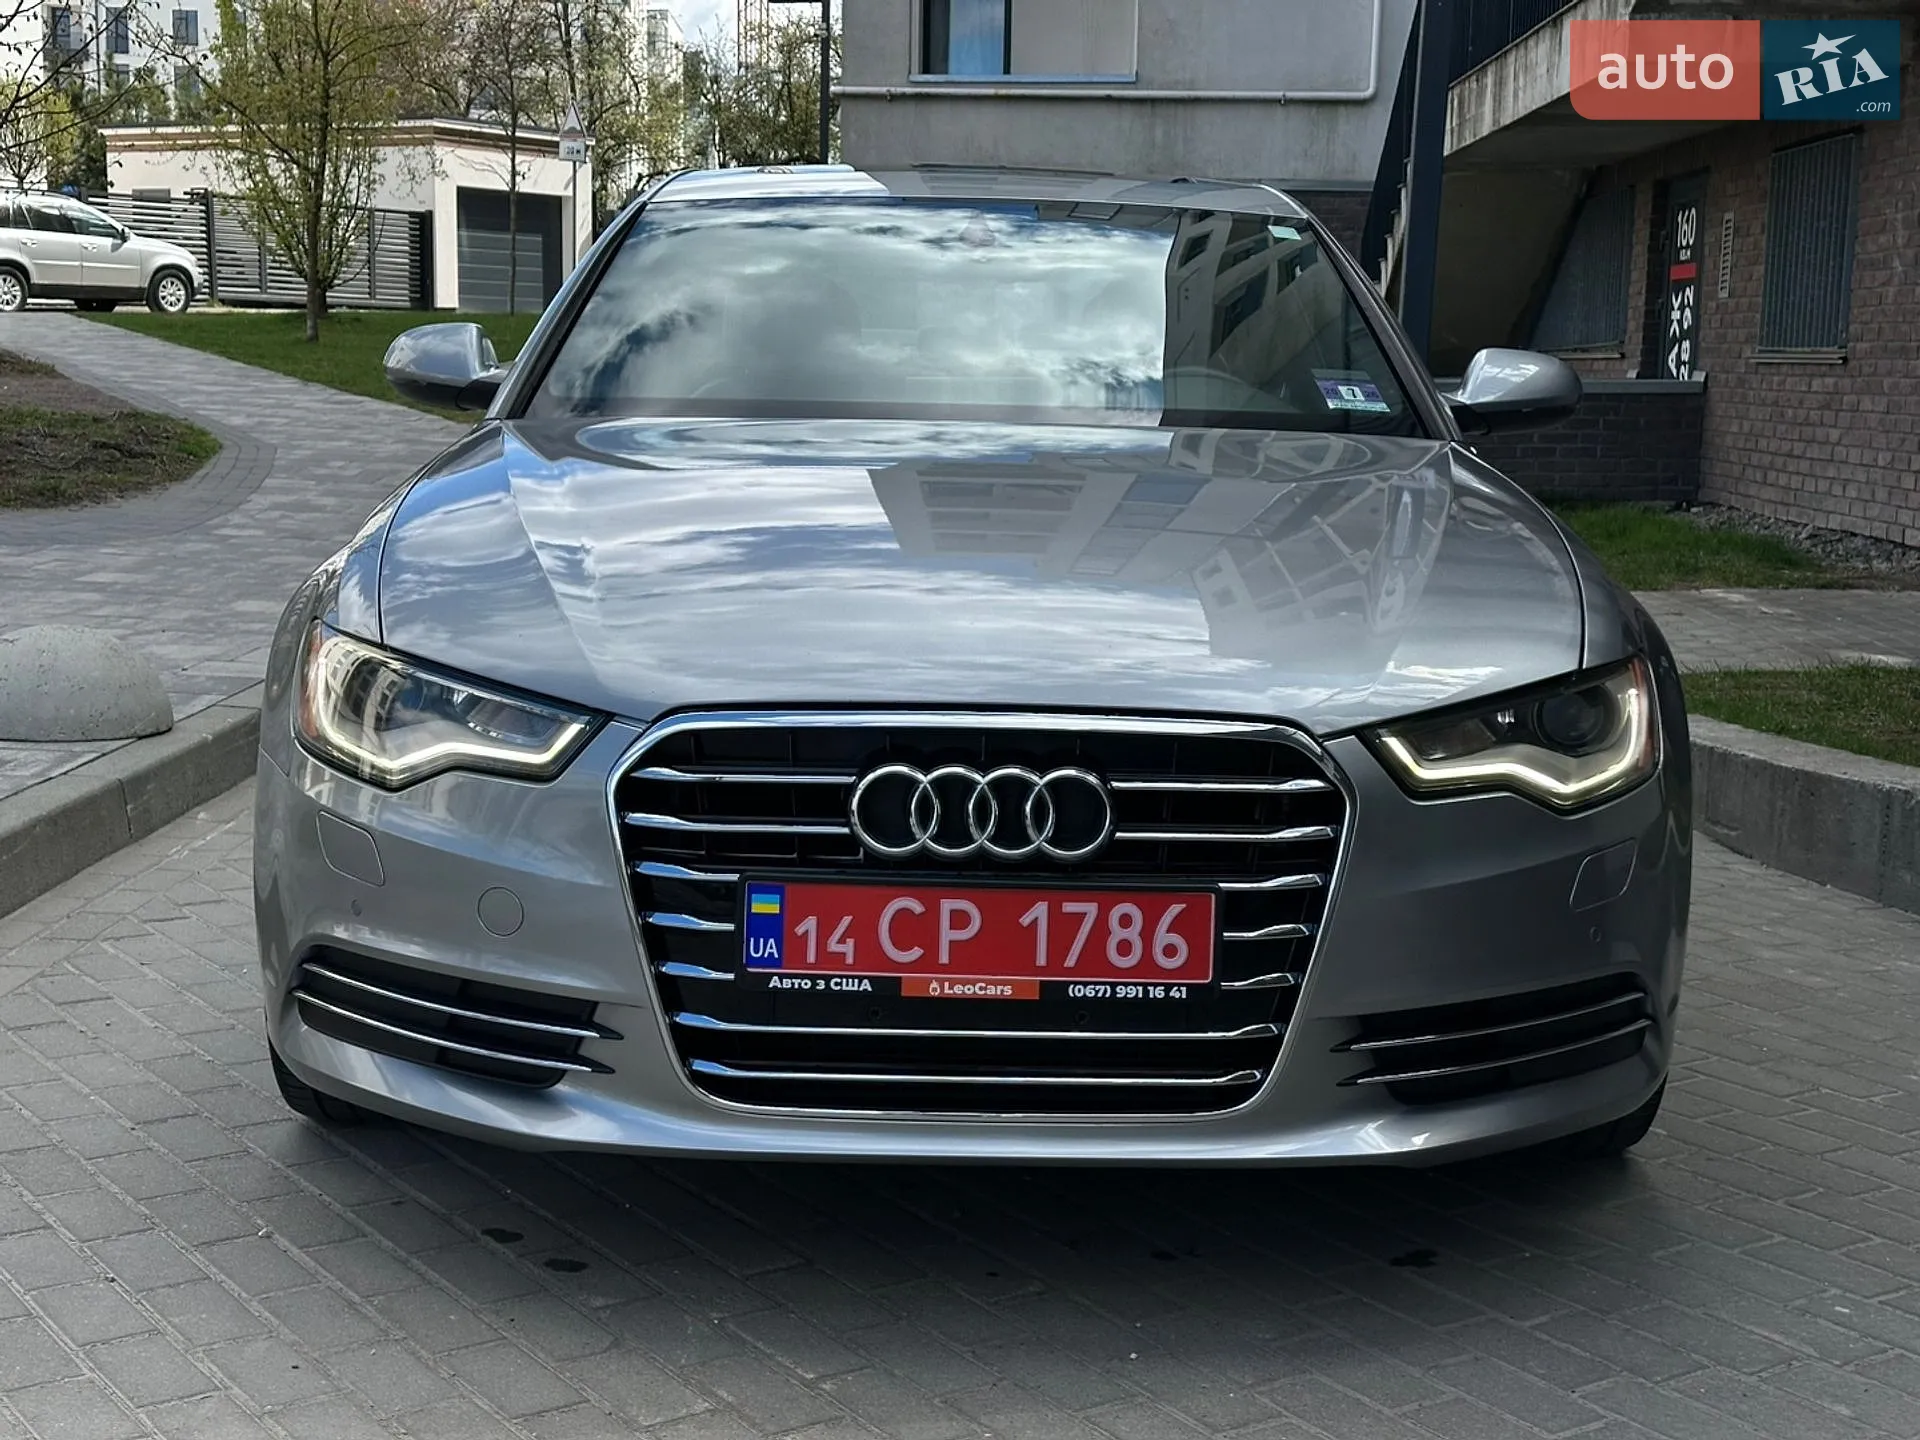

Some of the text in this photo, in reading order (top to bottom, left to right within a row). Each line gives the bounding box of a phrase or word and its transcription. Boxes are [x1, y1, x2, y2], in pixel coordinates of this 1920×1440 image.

[1677, 207, 1697, 248] 160
[794, 896, 1190, 970] 14 CP 1786
[750, 937, 779, 959] UA
[768, 976, 873, 991] Авто з США
[944, 982, 1013, 997] LeoCars
[1068, 984, 1187, 998] (067) 991 16 41
